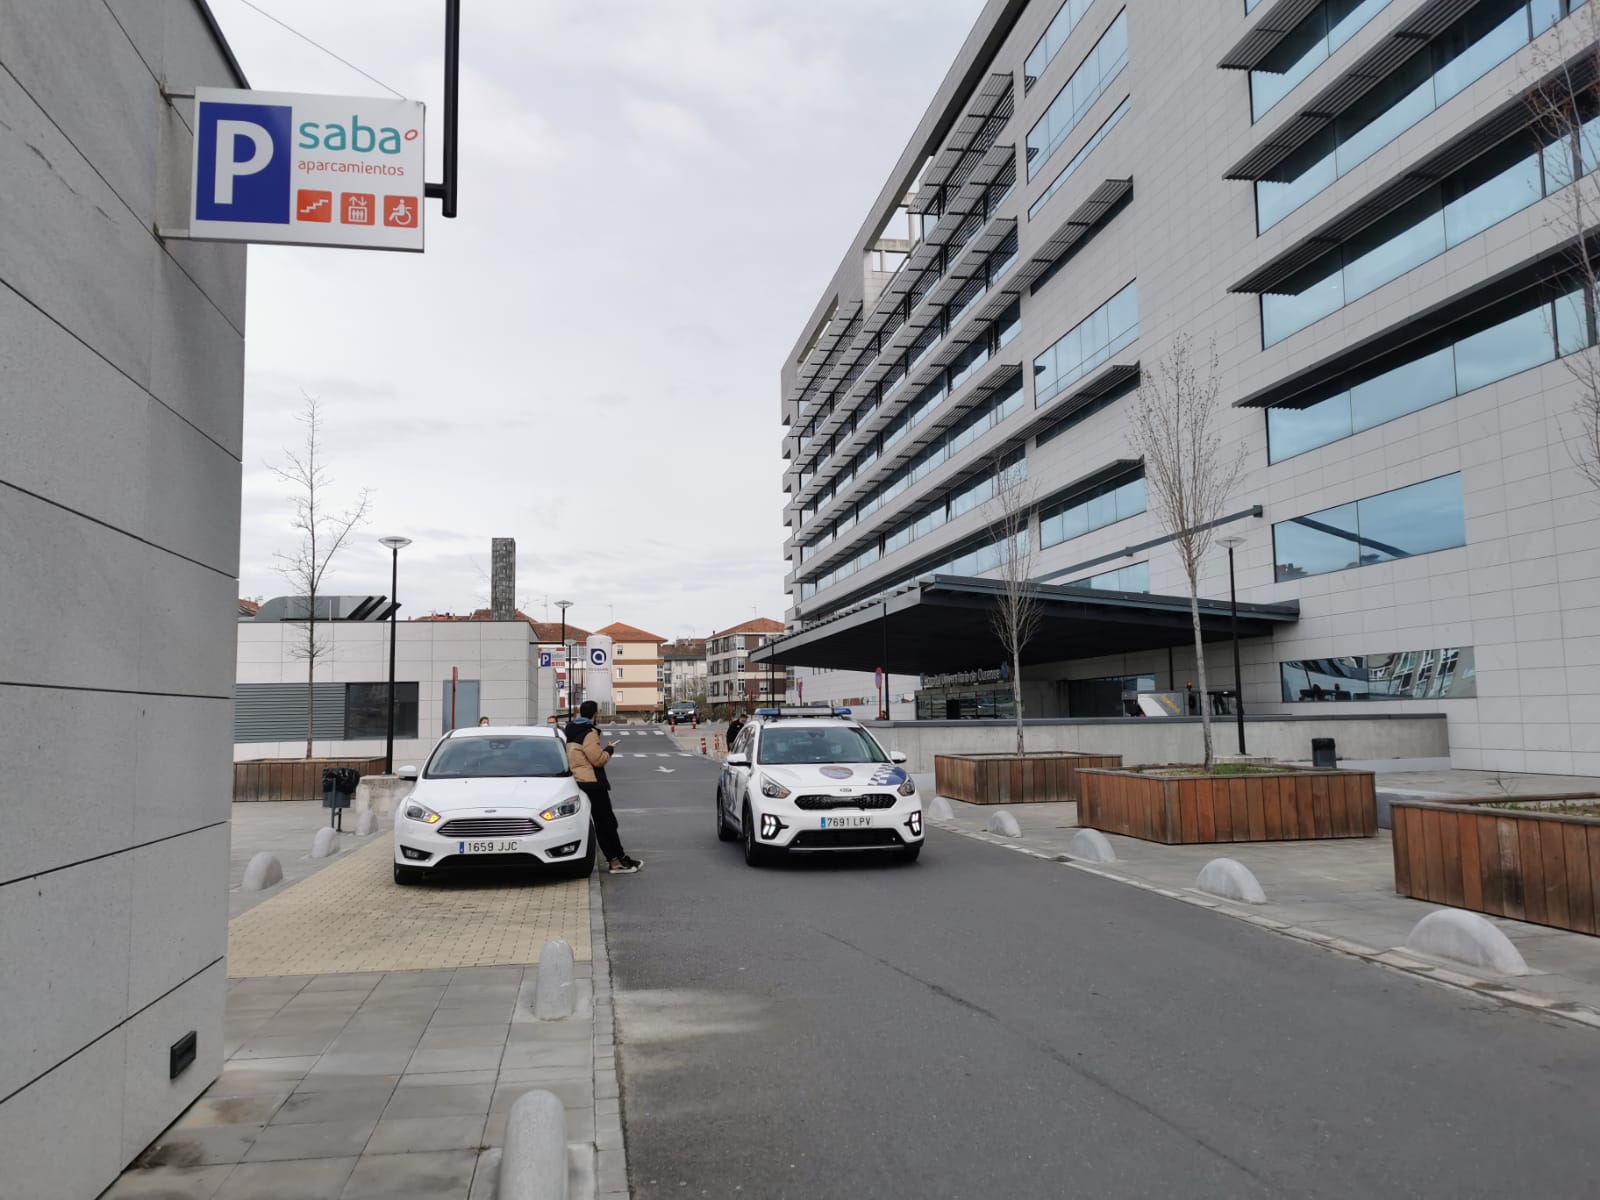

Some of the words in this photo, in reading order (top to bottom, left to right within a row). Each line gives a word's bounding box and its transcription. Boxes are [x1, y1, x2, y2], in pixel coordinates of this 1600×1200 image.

[298, 114, 401, 154] saba
[214, 119, 274, 205] P
[298, 159, 404, 176] aparcamientos
[542, 654, 549, 665] P
[827, 817, 849, 827] 7691
[853, 817, 871, 826] LPV
[468, 842, 494, 852] 1659
[498, 841, 518, 851] JJC
